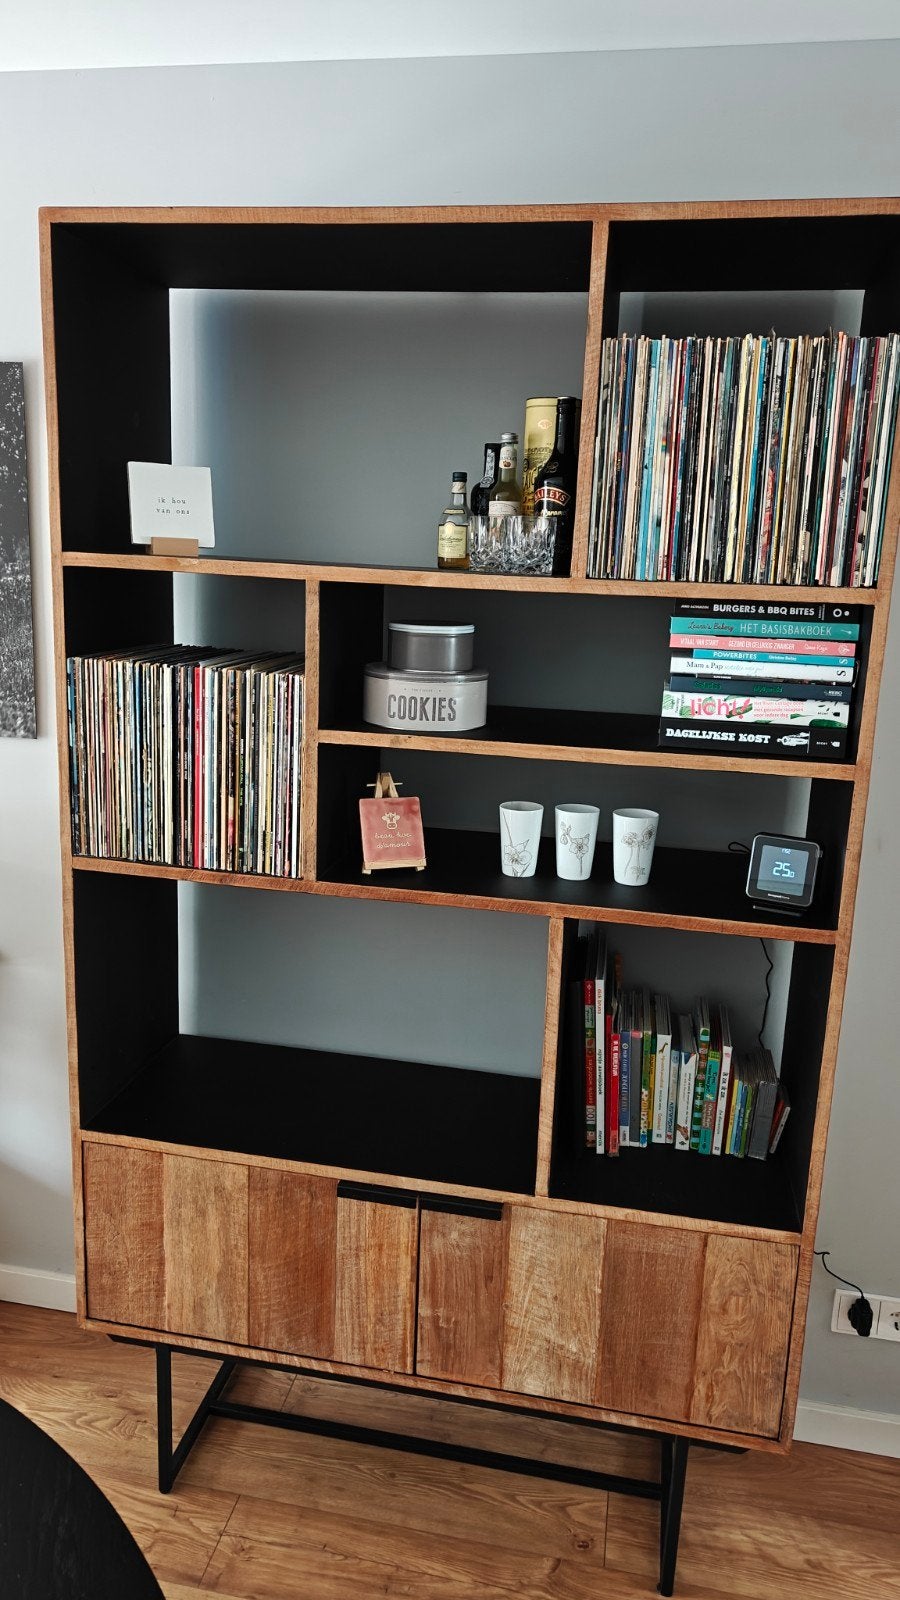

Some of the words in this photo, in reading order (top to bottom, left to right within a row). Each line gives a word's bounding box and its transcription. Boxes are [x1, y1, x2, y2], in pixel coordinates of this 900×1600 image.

[713, 604, 756, 613] BURGERS
[758, 606, 765, 614] &
[767, 606, 788, 615] BBQ
[790, 607, 815, 616] BITES
[740, 623, 758, 633] HET
[761, 624, 832, 636] BASISBAKBOEK
[713, 651, 758, 660] POWERBITES
[686, 661, 705, 669] Mam
[710, 662, 724, 671] Pap
[387, 694, 457, 722] COOKIES
[665, 728, 736, 742] DAGELIJKSE
[738, 733, 771, 744] KOST
